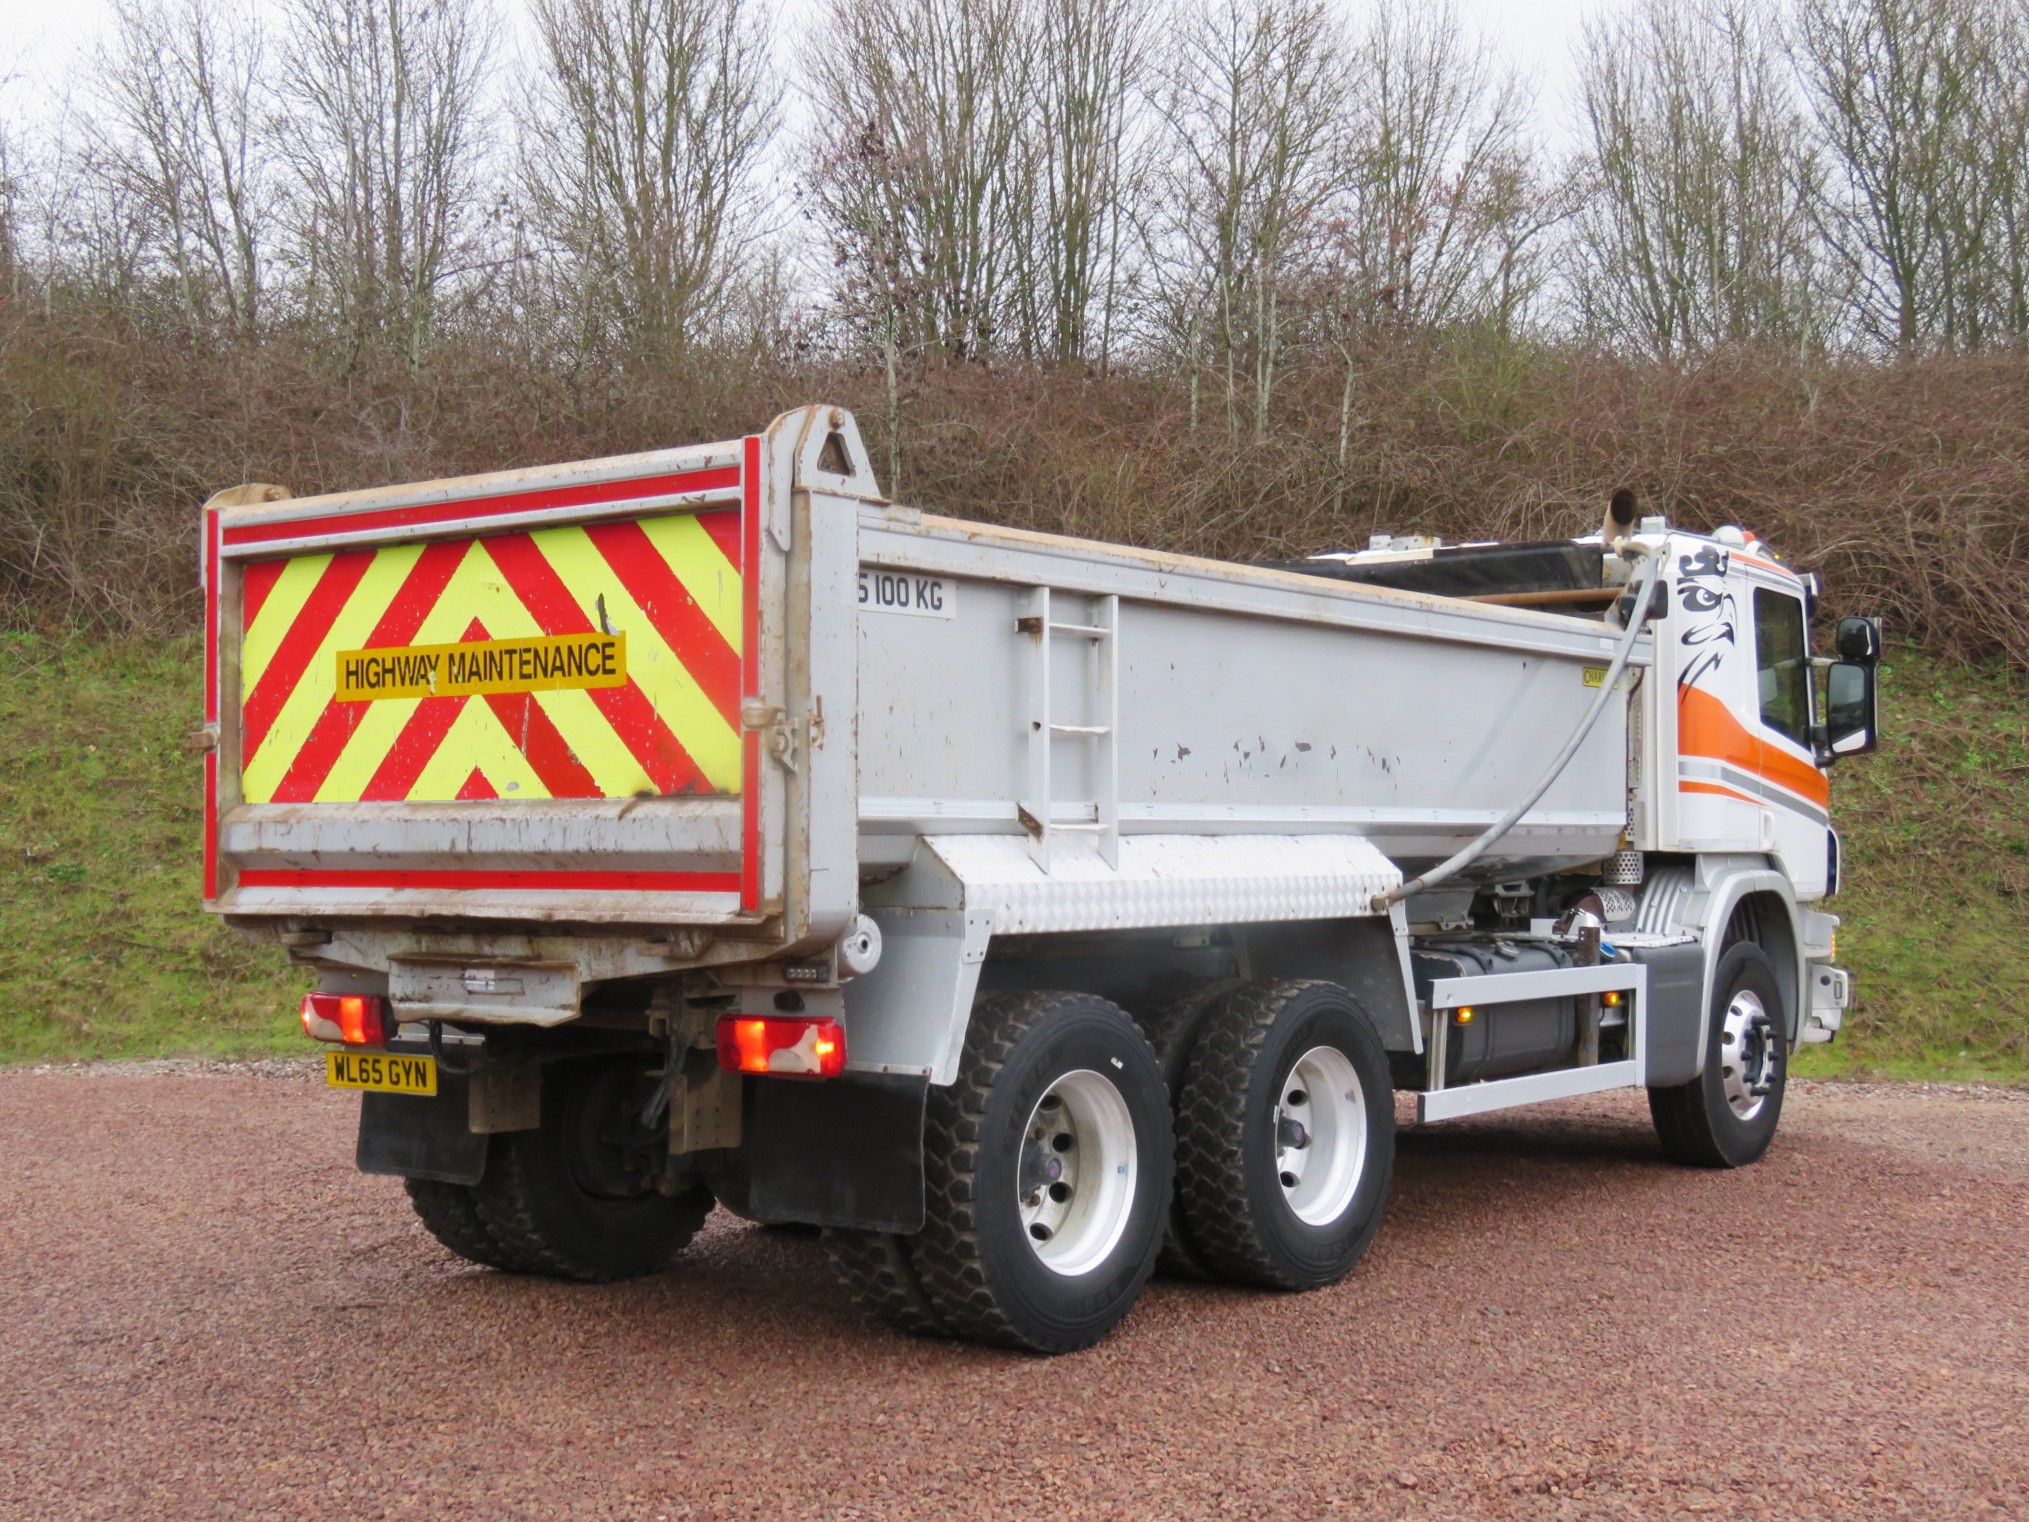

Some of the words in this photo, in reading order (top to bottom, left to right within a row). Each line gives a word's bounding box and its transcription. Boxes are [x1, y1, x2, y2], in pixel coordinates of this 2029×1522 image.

[915, 578, 943, 611] KG
[344, 653, 441, 690] HIGHWAY
[447, 641, 617, 685] MAINTENANCE
[333, 1055, 384, 1085] WL65
[388, 1059, 428, 1088] GYN
